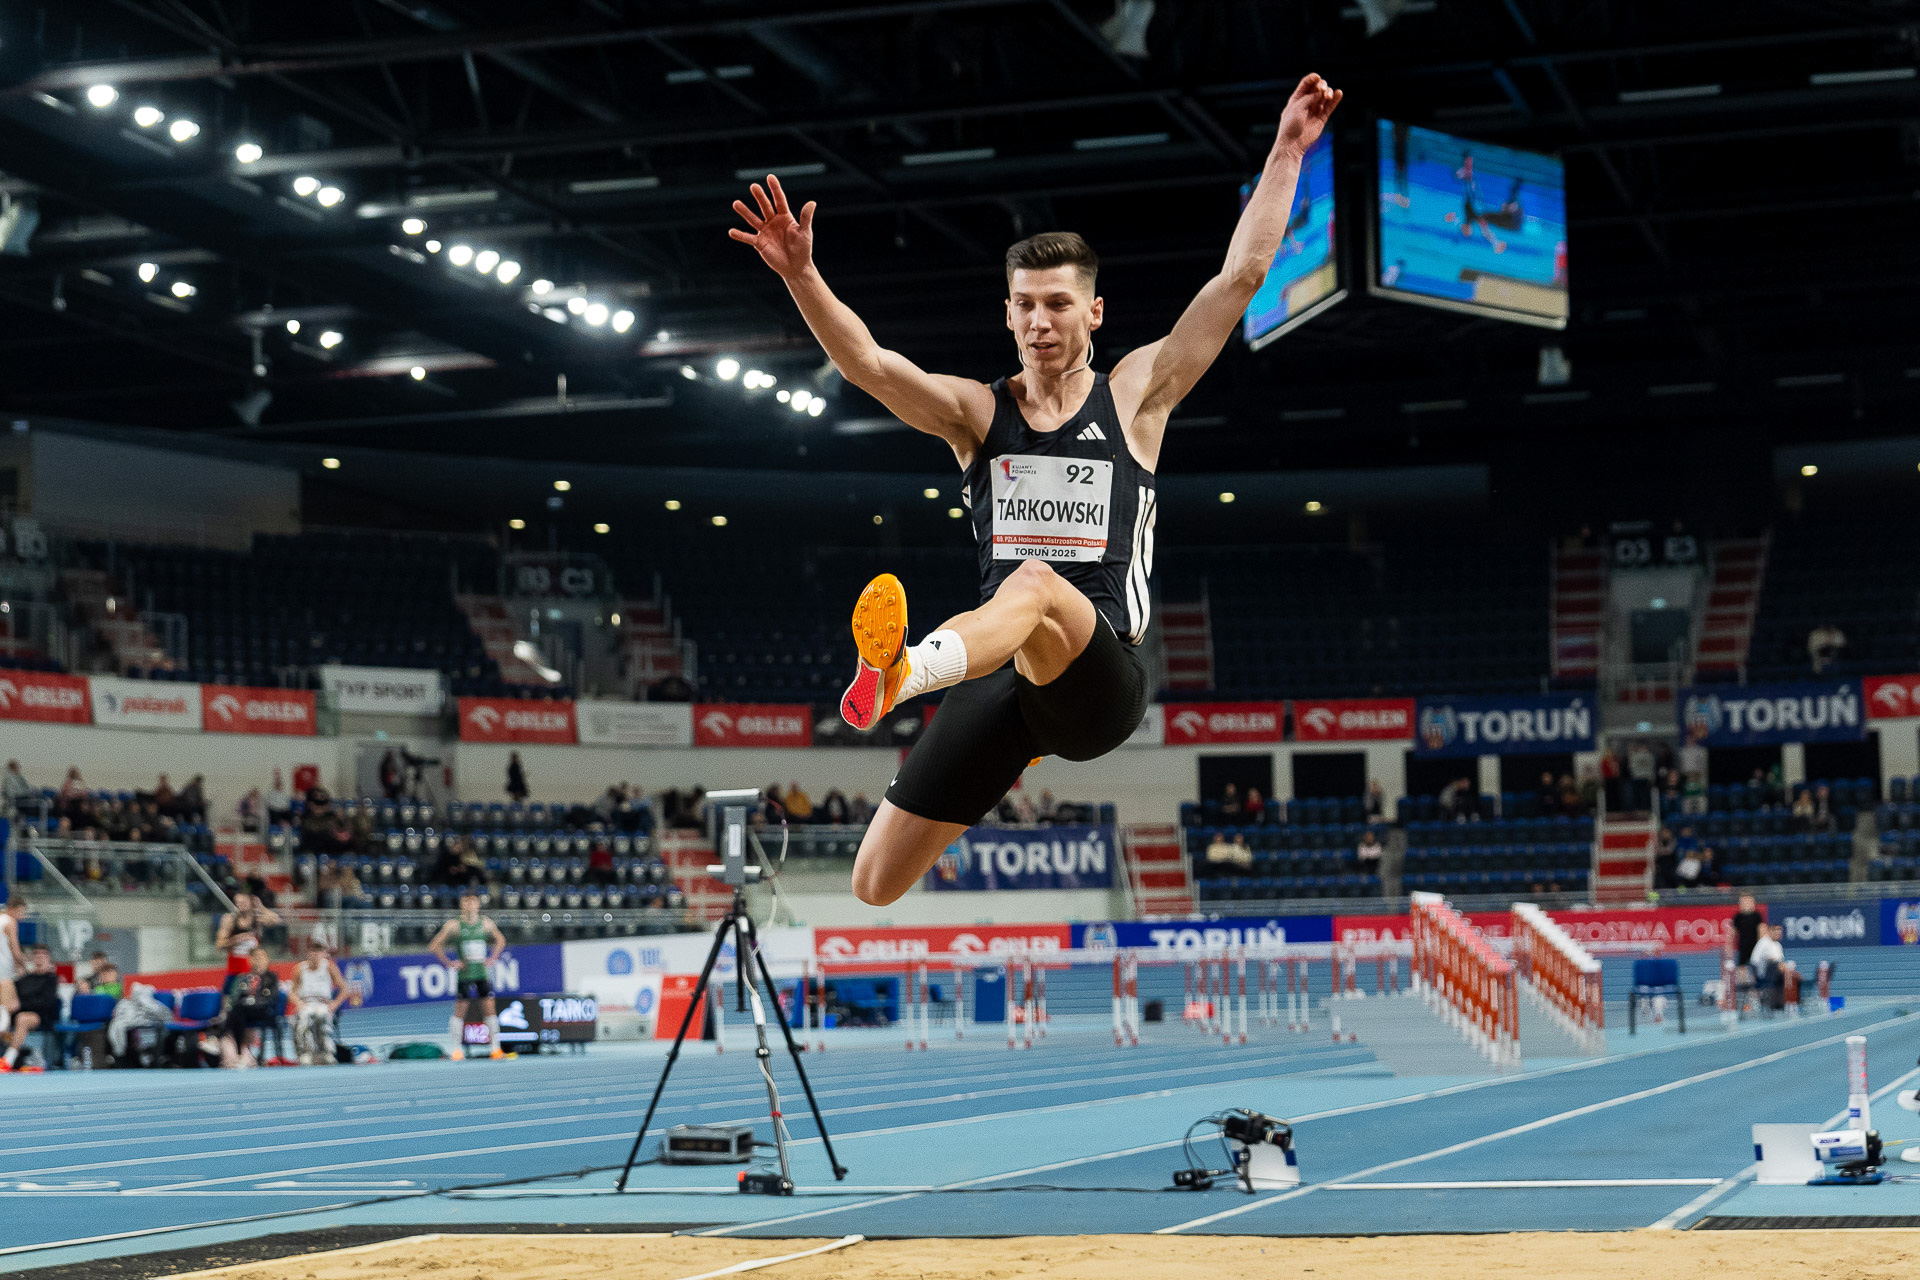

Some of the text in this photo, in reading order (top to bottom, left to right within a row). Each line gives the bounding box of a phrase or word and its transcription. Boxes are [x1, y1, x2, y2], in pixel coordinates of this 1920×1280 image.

[1066, 464, 1094, 485] 92
[997, 498, 1104, 526] TARKOWSKI
[1014, 546, 1077, 558] TORUŃ 2025
[1019, 536, 1041, 544] Halowe
[1043, 537, 1082, 546] Mistrzostwa
[245, 700, 308, 722] ORLEN
[1459, 697, 1591, 744] TORUŃ
[1724, 683, 1858, 733] TORUŃ
[972, 830, 1107, 877] TORUŃ
[1150, 919, 1286, 952] TORUŃ
[1783, 908, 1865, 940] TORUŃ
[399, 951, 520, 1000] TOŃ
